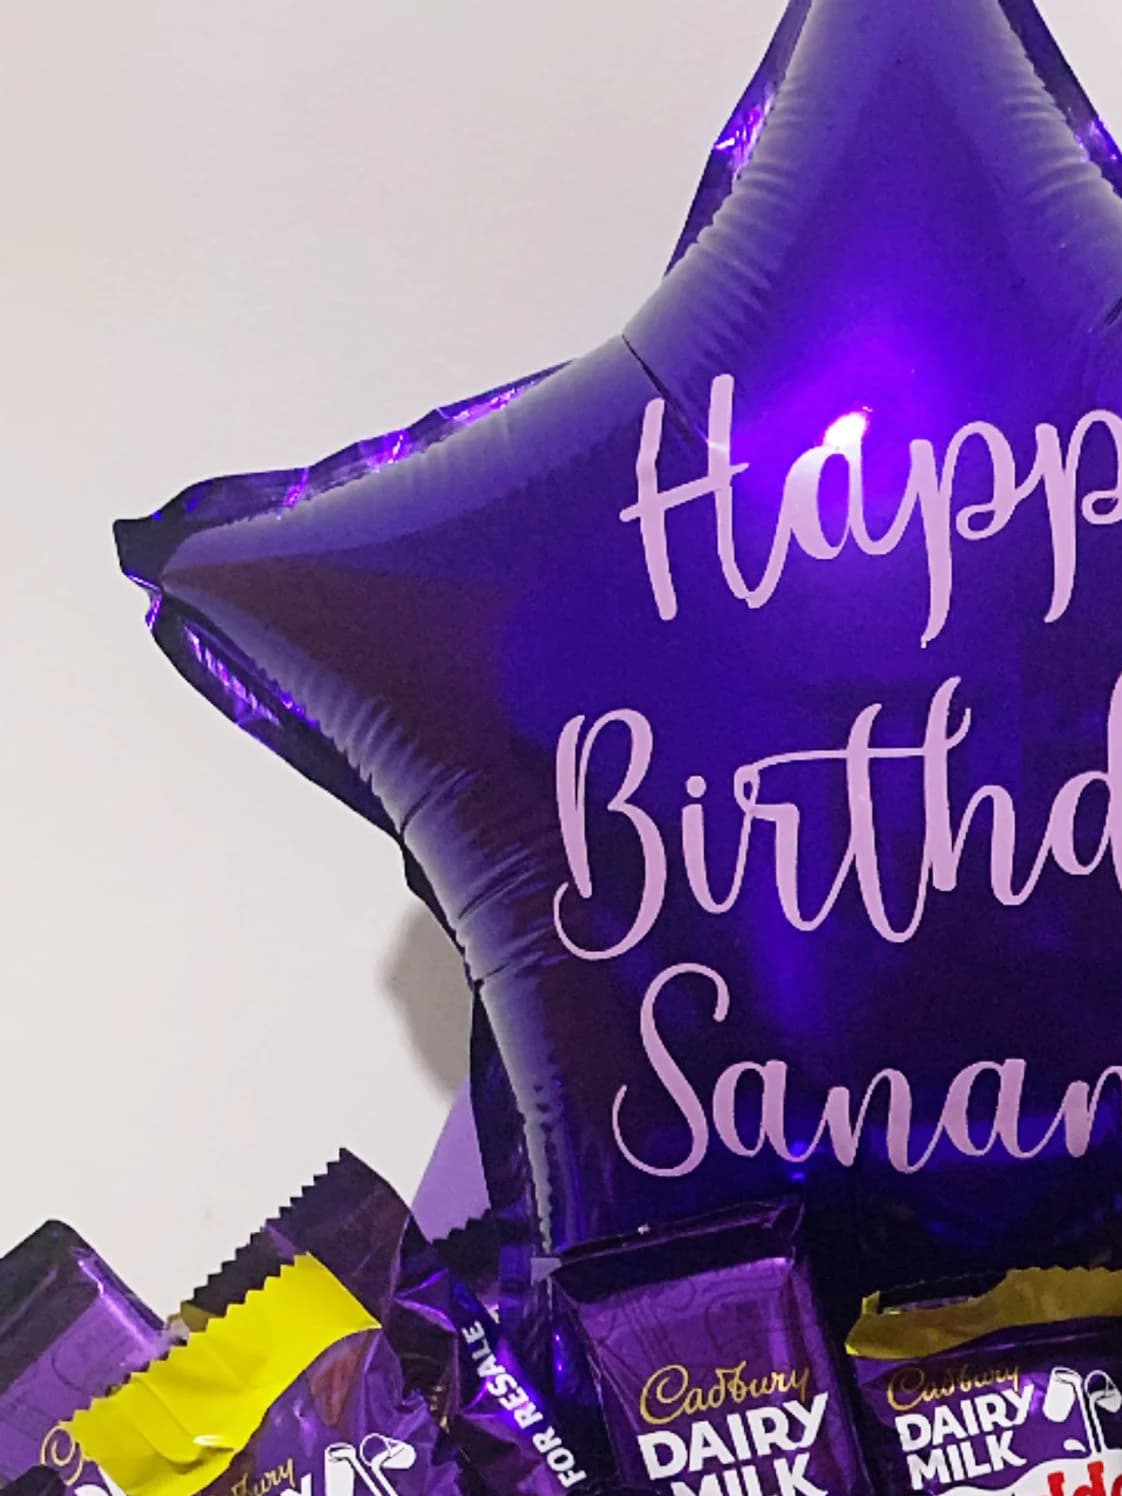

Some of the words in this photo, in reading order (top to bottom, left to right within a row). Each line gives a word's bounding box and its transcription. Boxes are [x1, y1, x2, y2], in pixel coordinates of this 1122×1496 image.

[461, 1320, 543, 1429] RESALE
[639, 1361, 810, 1426] Cadbury
[886, 1363, 1021, 1411] Cadbury
[637, 1391, 829, 1480] DAIRY
[895, 1383, 1036, 1453] DAIRY
[532, 1426, 587, 1488] FOR
[906, 1430, 1027, 1491] MILK
